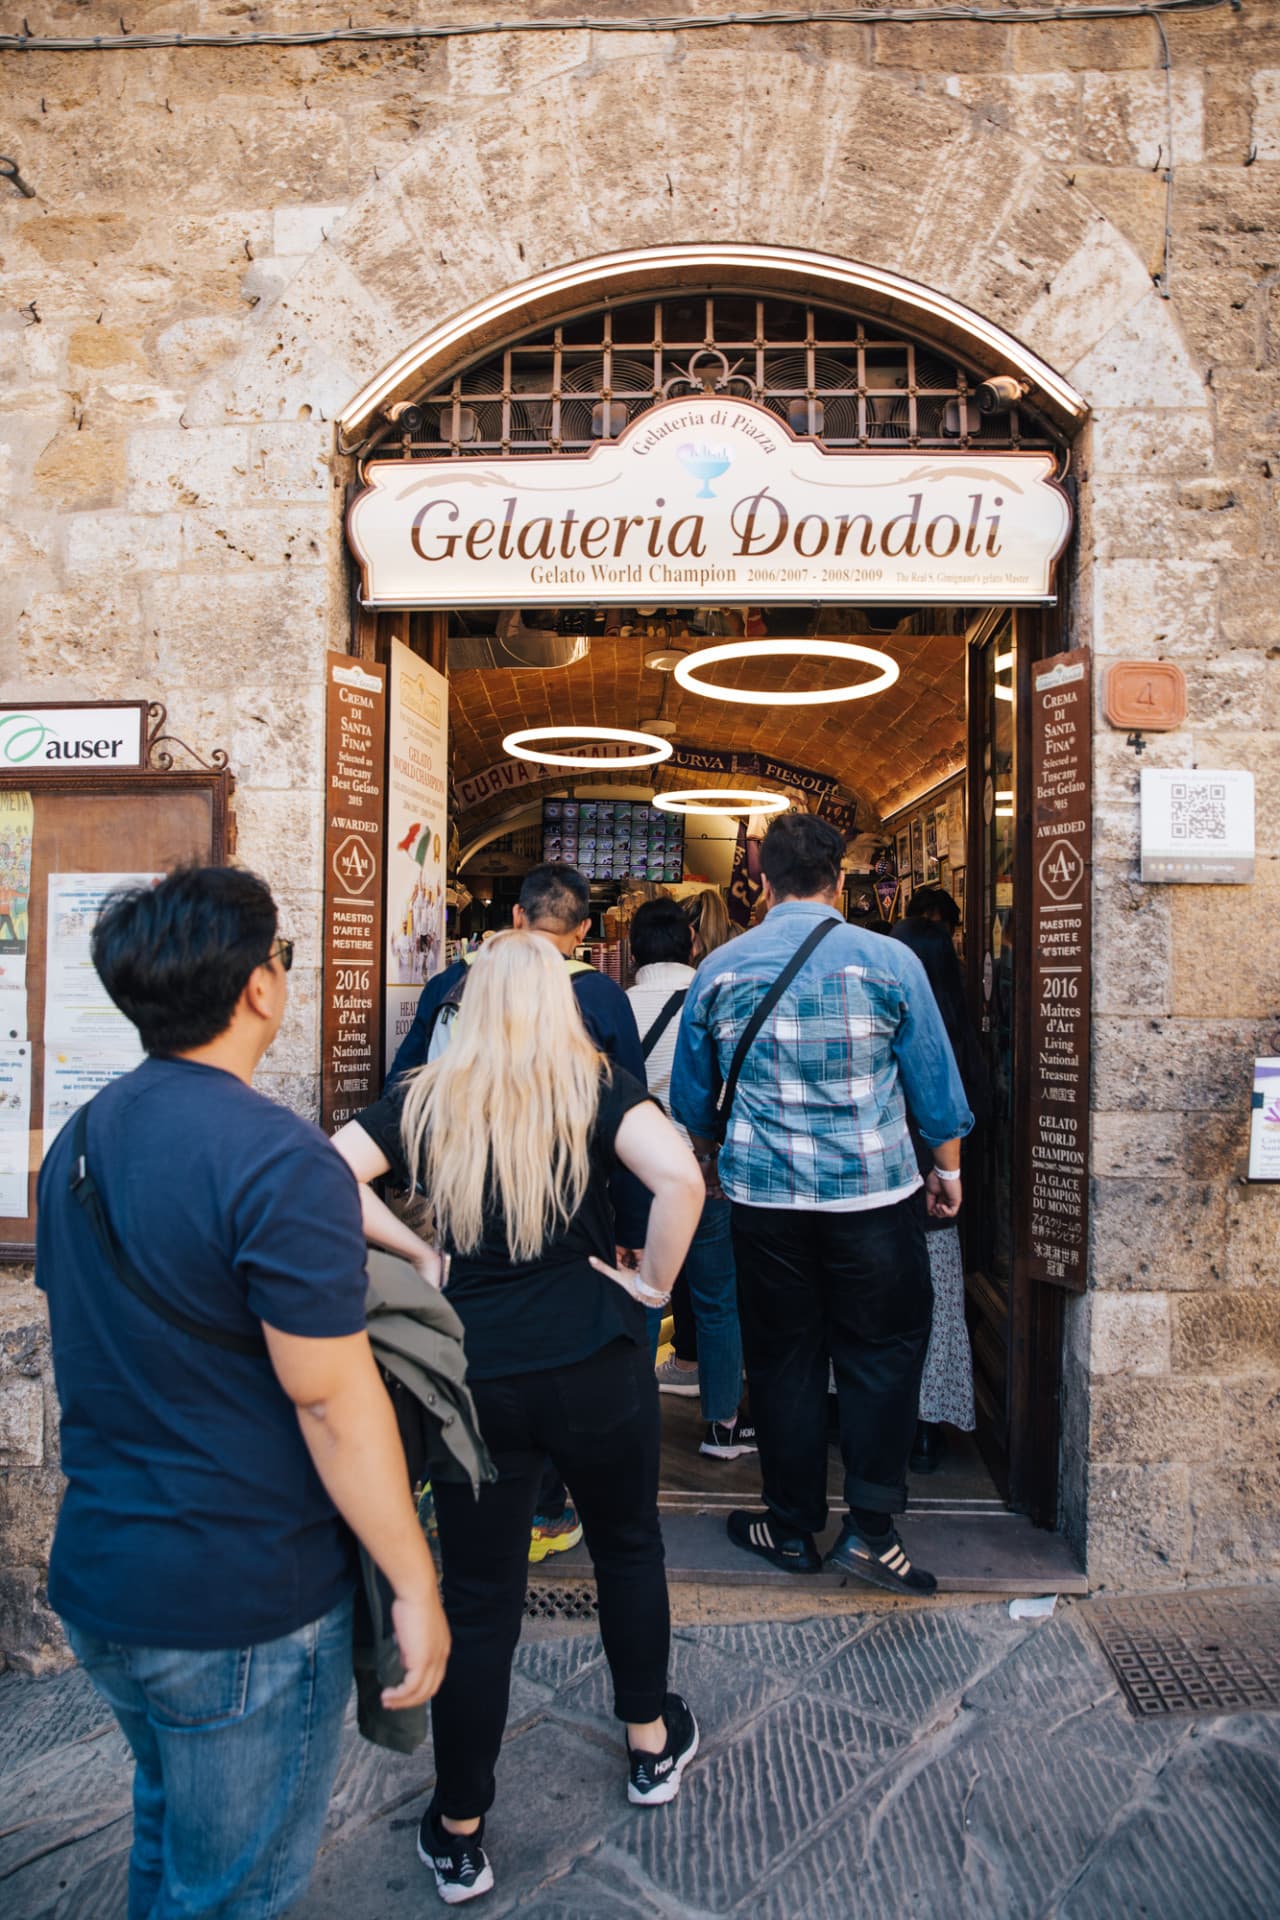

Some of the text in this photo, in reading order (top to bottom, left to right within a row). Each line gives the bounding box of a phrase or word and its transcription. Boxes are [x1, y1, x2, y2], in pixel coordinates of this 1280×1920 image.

[631, 410, 777, 456] Gelateria di Piazza
[410, 486, 1005, 562] Gelateria Dondoli
[530, 565, 585, 584] Gelato
[591, 564, 642, 582] World
[649, 563, 737, 587] Champion
[747, 568, 809, 582] 2006/2007
[821, 567, 883, 582] 2008/2009
[339, 687, 374, 709] CREMA
[1042, 691, 1078, 709] CREMA
[351, 707, 362, 721] DI
[1054, 709, 1065, 721] DI
[340, 716, 372, 737] SANTA
[1044, 721, 1077, 738] SANTA
[45, 738, 123, 760] auser
[338, 752, 365, 766] Selected
[1042, 755, 1069, 769] Selected
[337, 762, 372, 783] Tuscany
[1042, 768, 1078, 785] Tuscany
[332, 775, 351, 790] Best
[352, 779, 379, 796] Gelato
[462, 762, 529, 803] CURVA
[1037, 779, 1086, 799] Best Gelato
[331, 816, 379, 833] AWARDED
[1037, 819, 1086, 838] AWARDED
[333, 911, 374, 924] MAESTRO
[1039, 918, 1082, 930] MAESTRO
[364, 927, 371, 937] E
[1071, 932, 1079, 942] E
[332, 938, 374, 950] MESTIERE
[335, 969, 370, 991] 2016
[1042, 977, 1078, 999] 2016
[400, 1001, 418, 1017] HEAL
[338, 1030, 366, 1046] Living
[1044, 1036, 1074, 1054] Living
[332, 1045, 371, 1057] National
[1039, 1052, 1079, 1066] National
[332, 1061, 371, 1073] Treasure
[1039, 1067, 1079, 1082] Treasure
[1038, 1115, 1078, 1132] GELATO
[1040, 1130, 1076, 1147] WORLD
[1031, 1146, 1084, 1164] CHAMPION
[1035, 1172, 1079, 1191] LA GLACE
[1033, 1184, 1081, 1203] CHAMPION
[1033, 1197, 1082, 1217] DU MONDE
